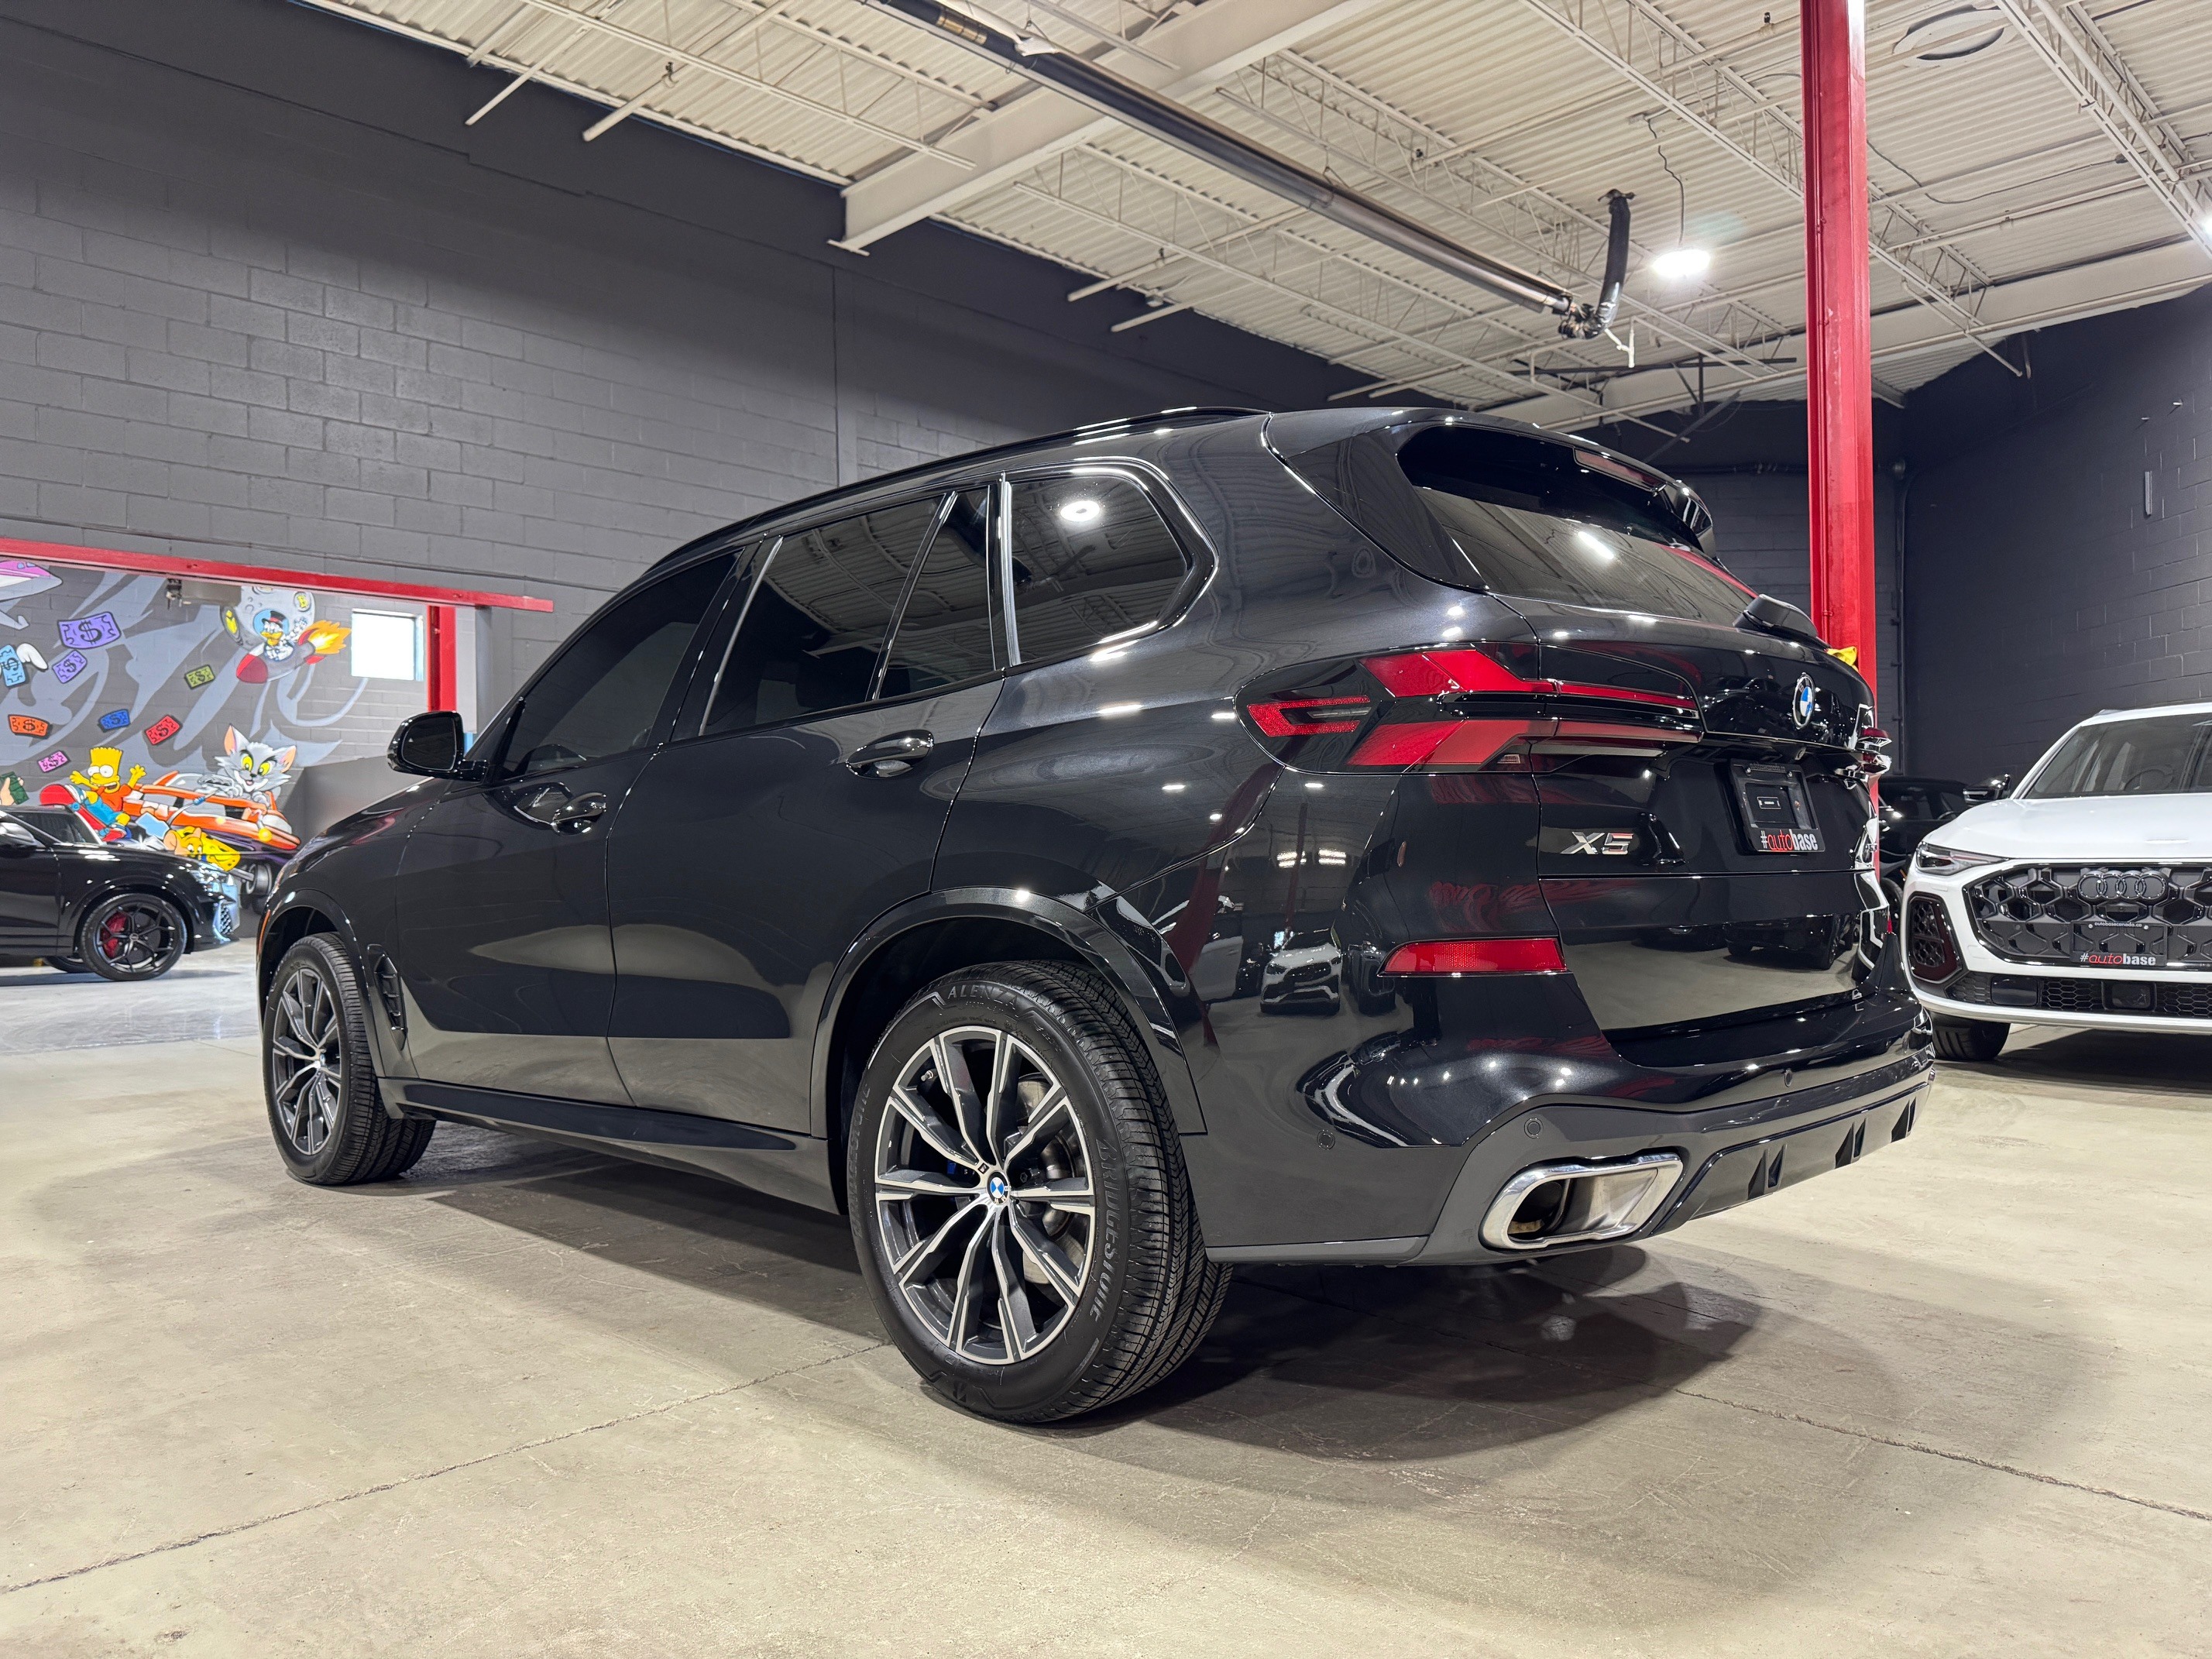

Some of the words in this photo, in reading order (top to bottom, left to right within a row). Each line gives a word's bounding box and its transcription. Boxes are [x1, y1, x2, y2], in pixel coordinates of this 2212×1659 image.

[1561, 832, 1633, 854] X5
[1760, 828, 1819, 851] #autobase
[2080, 953, 2156, 966] #autobase
[947, 984, 1018, 1006] ALENZA
[1089, 1139, 1121, 1321] BRIDGESTONE
